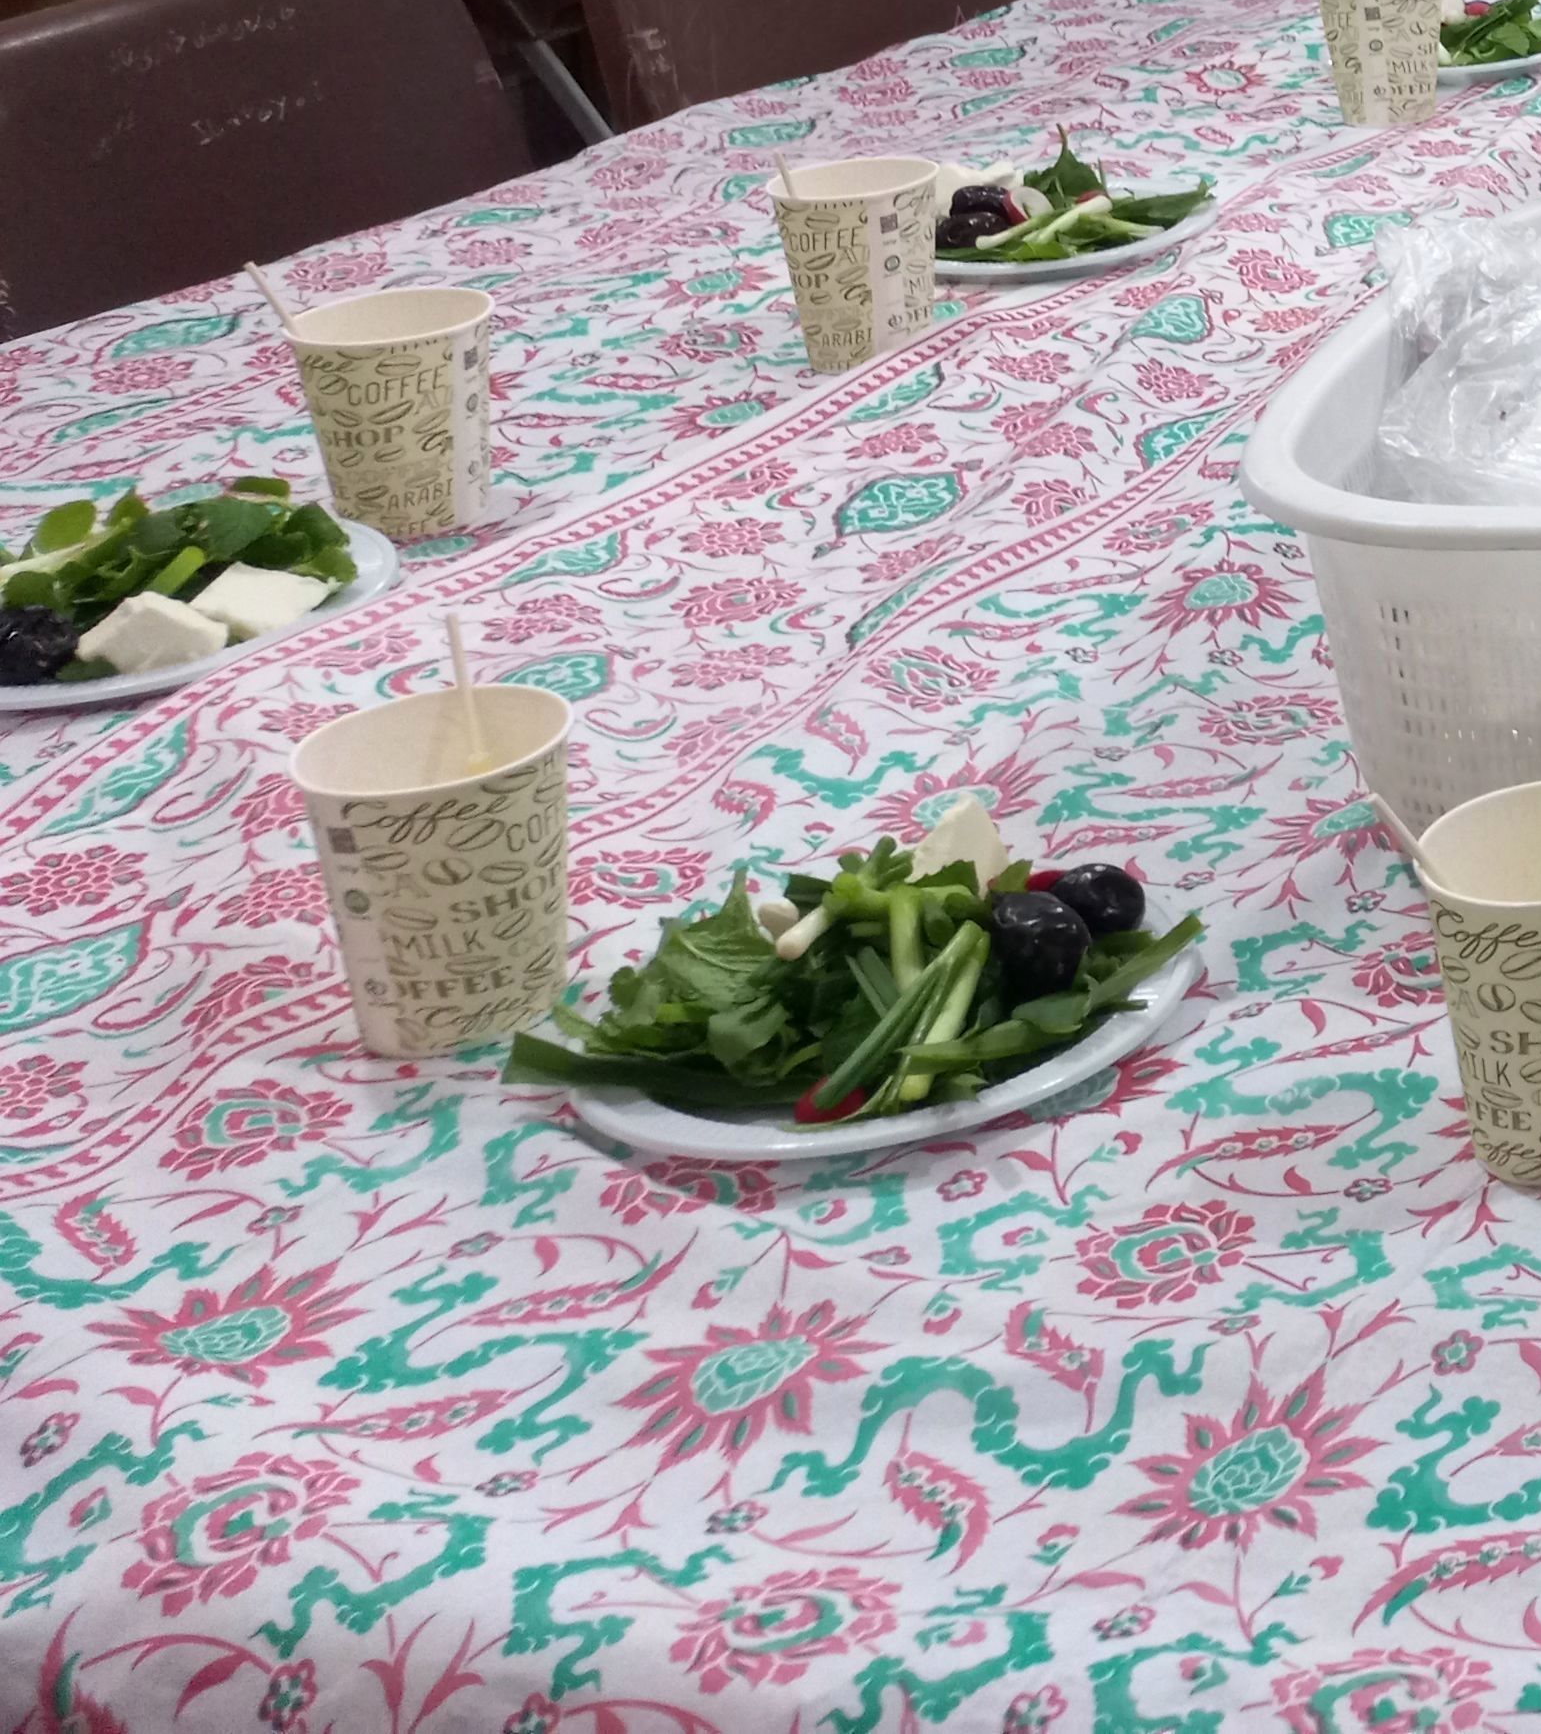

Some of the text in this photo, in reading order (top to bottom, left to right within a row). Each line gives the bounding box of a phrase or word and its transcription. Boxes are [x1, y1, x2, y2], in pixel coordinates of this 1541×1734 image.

[790, 226, 864, 252] COFFEE
[348, 364, 448, 406] COFFEE
[340, 795, 518, 845] Coffee
[449, 861, 562, 923] SHOP
[391, 929, 485, 960] MILK
